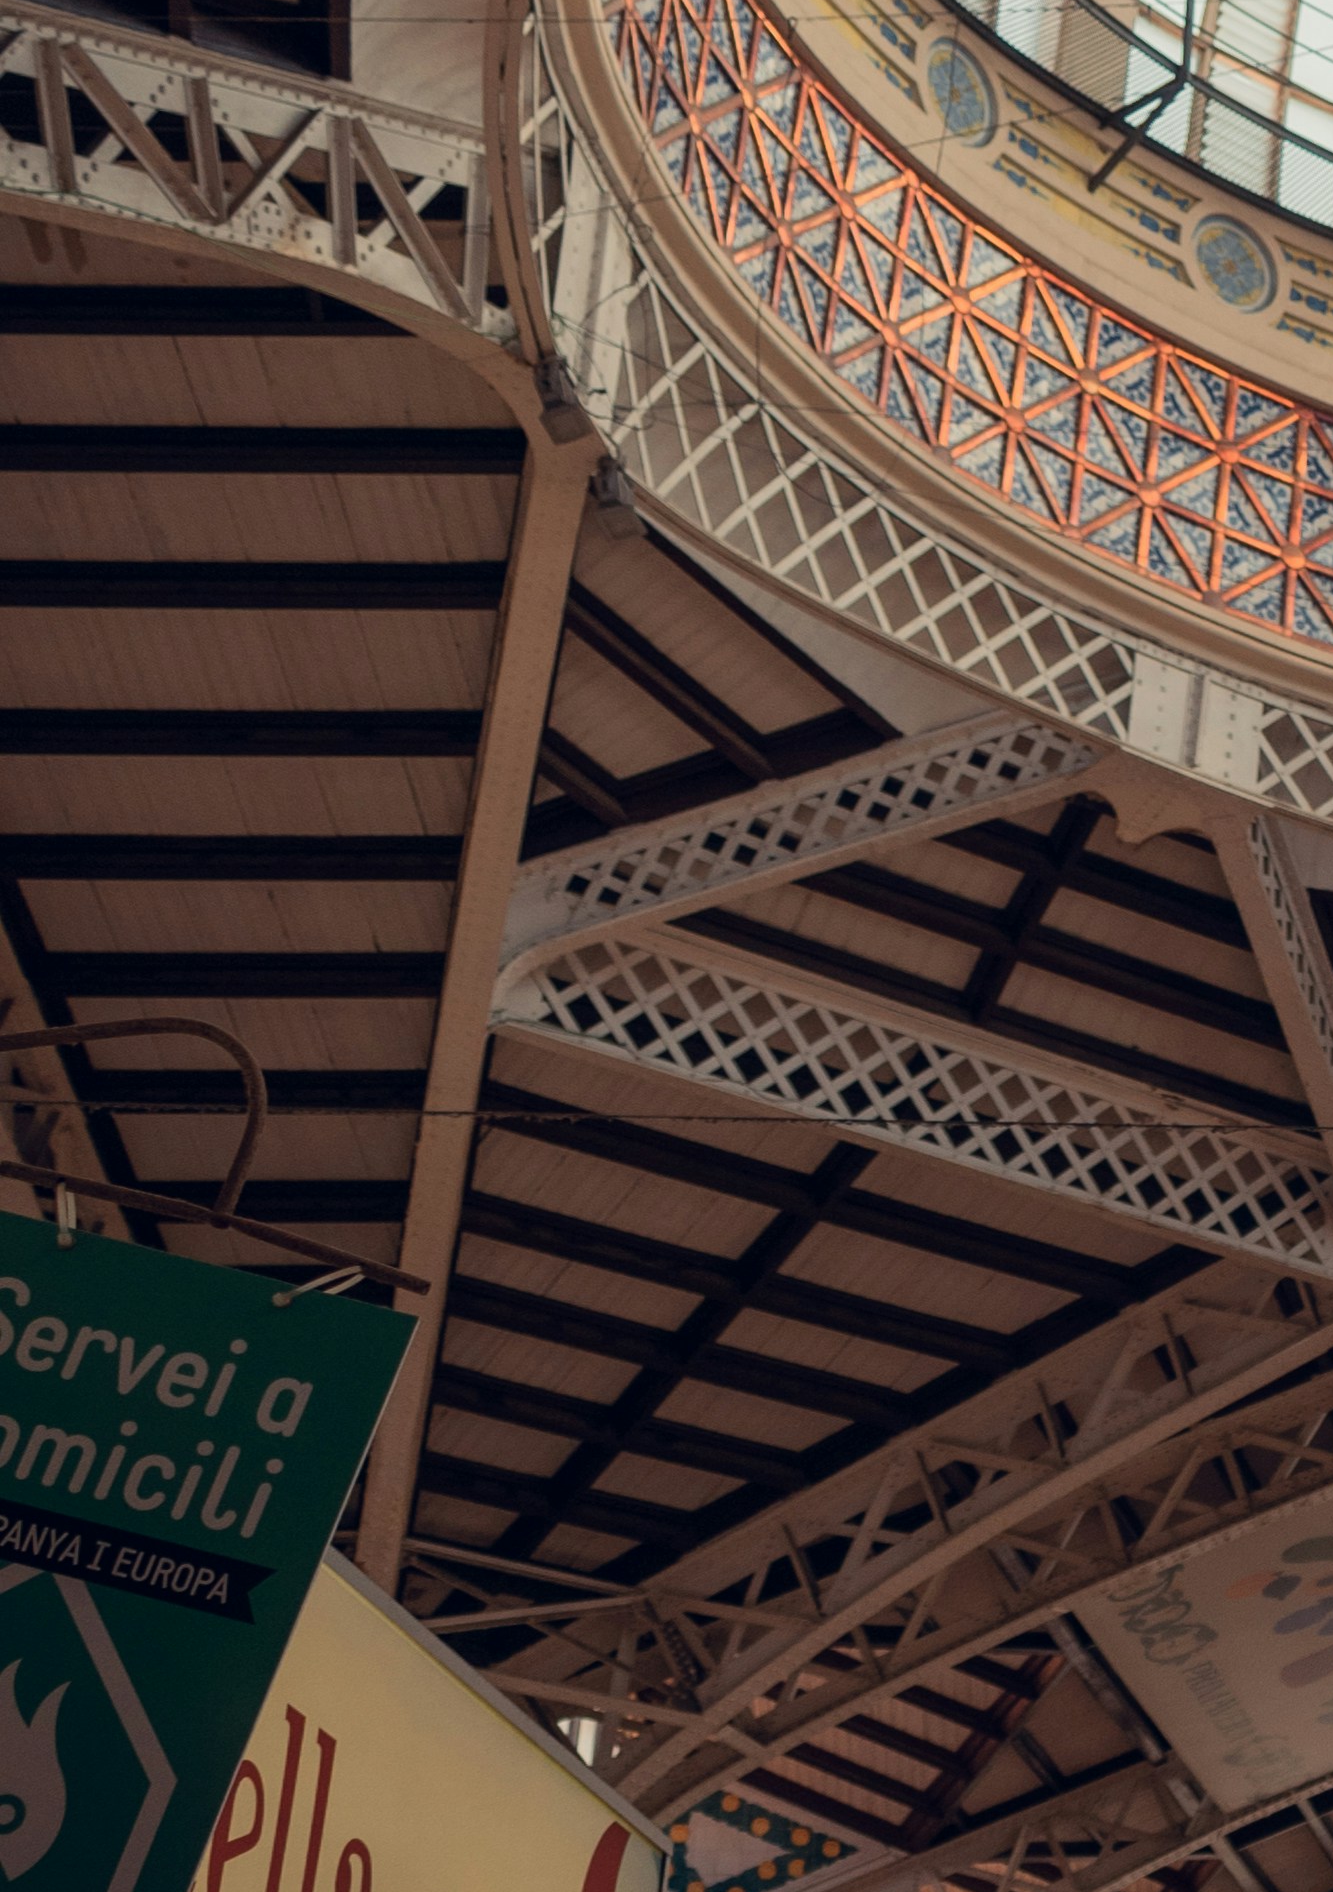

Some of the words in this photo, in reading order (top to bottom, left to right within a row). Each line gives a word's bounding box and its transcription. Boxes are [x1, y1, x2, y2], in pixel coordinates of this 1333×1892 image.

[256, 1377, 313, 1438] a
[0, 1515, 83, 1566] ANYA
[85, 1541, 112, 1571] I
[111, 1547, 230, 1605] EUROPA
